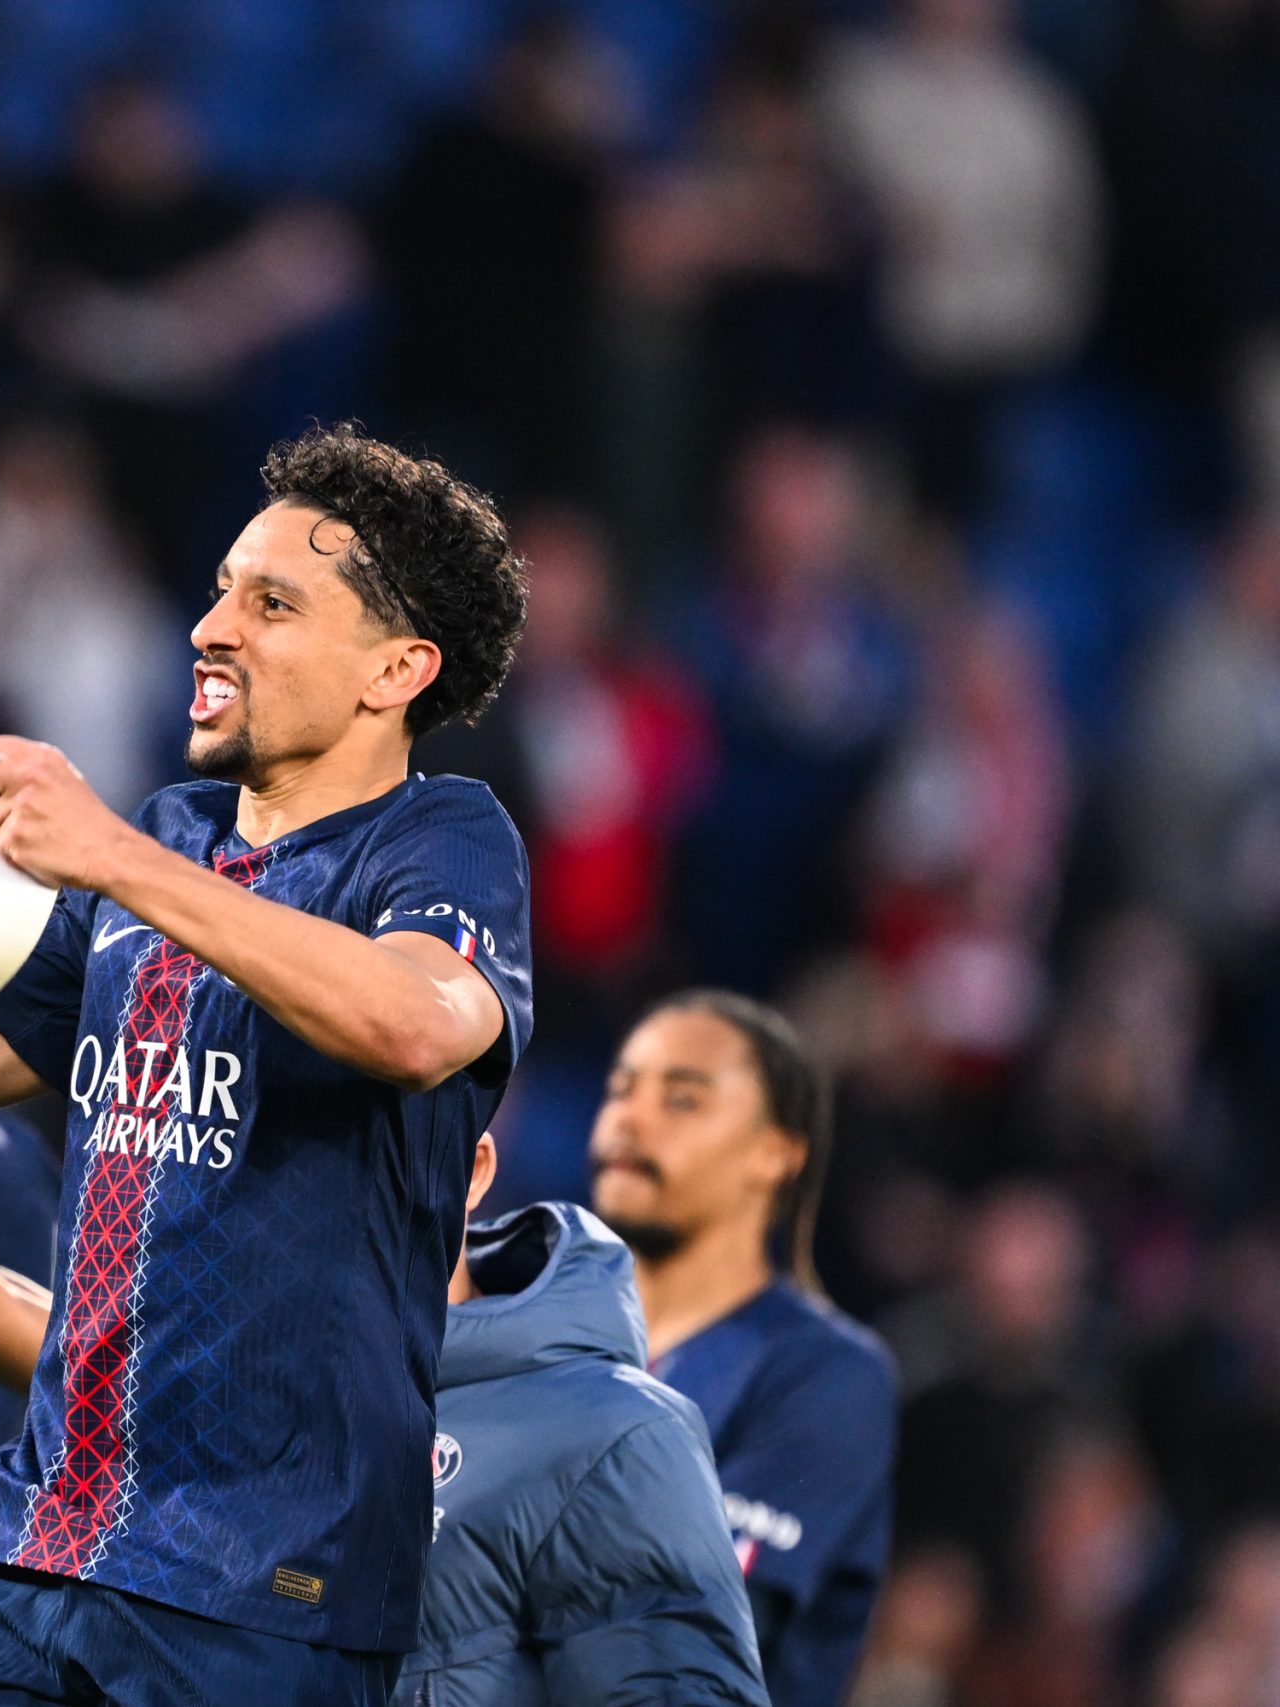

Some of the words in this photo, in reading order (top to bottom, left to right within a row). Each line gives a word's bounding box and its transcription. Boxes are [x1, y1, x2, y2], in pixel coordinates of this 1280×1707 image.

[377, 903, 496, 956] EOND
[70, 1034, 241, 1120] QATAR
[83, 1112, 236, 1170] AIRWAYS
